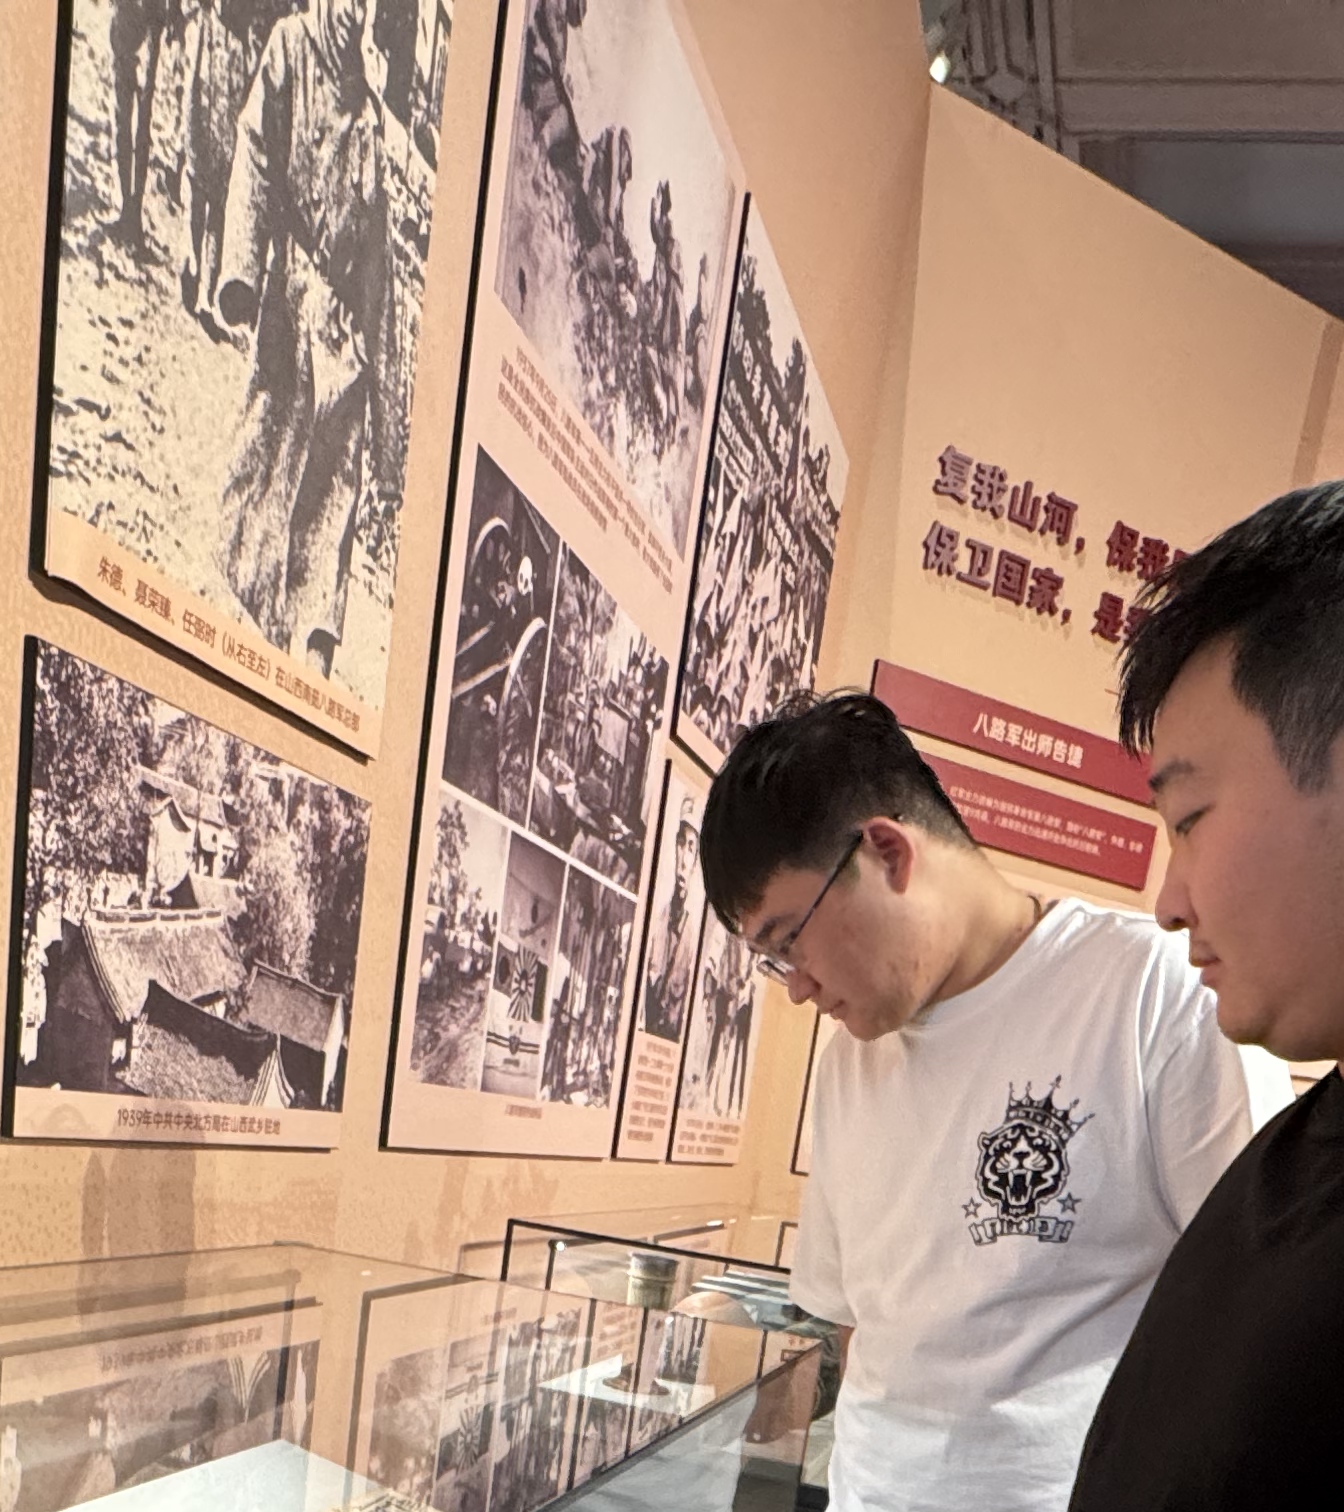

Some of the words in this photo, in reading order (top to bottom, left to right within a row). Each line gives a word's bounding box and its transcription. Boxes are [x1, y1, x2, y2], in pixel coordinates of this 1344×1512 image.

[972, 712, 1084, 769] 八路军出师告捷
